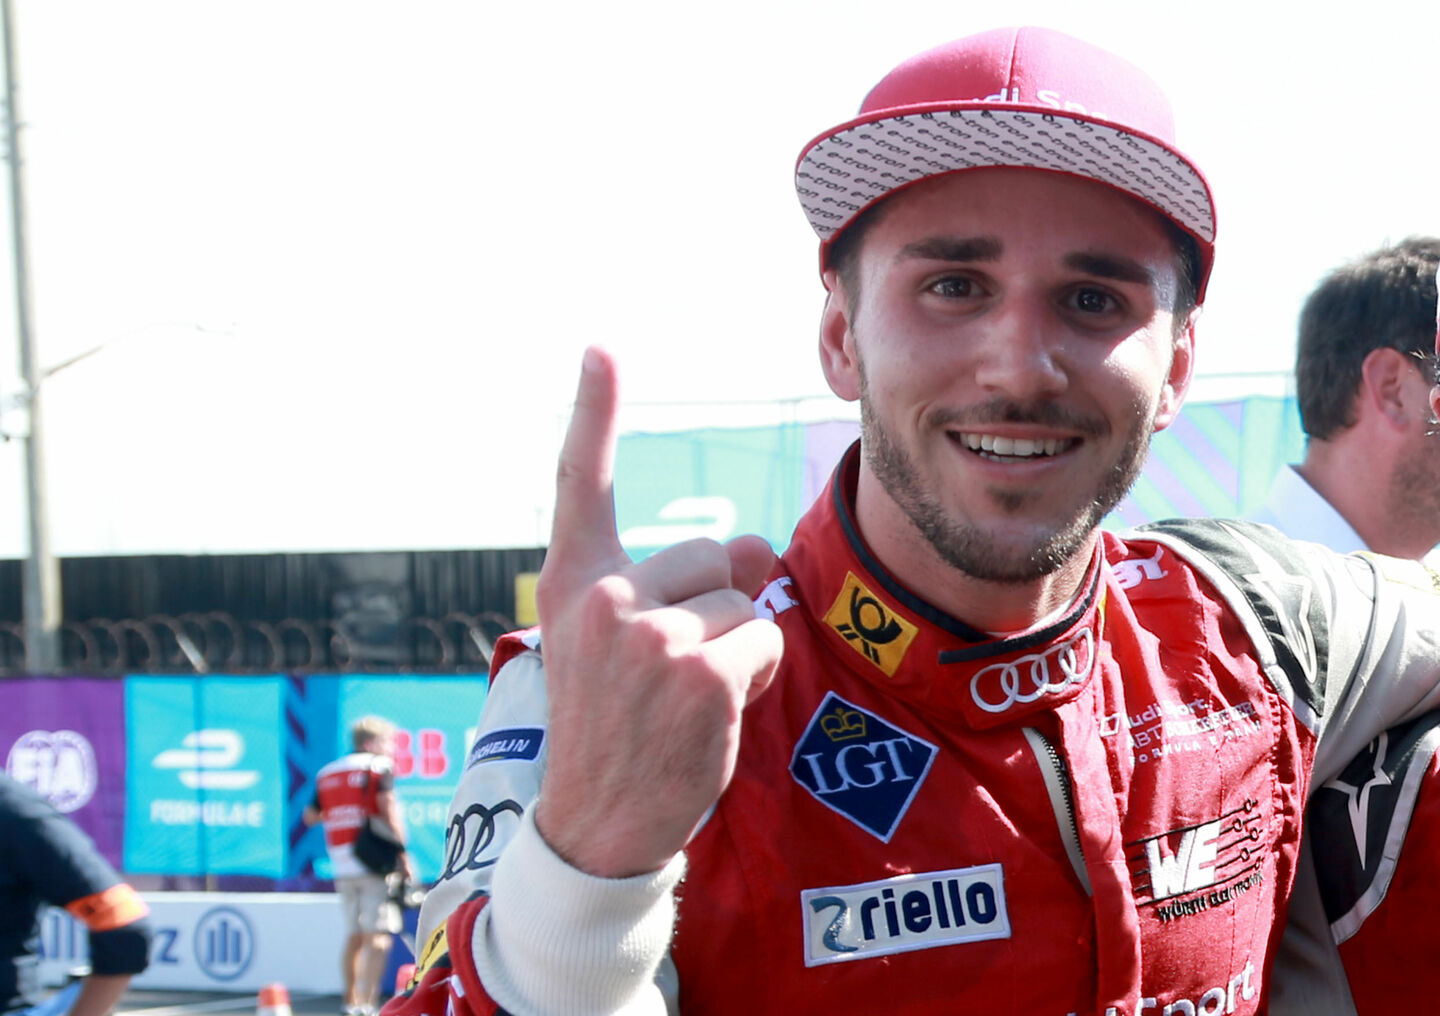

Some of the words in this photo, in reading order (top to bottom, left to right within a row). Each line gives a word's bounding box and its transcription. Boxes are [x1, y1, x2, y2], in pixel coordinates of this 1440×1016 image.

[860, 134, 910, 155] e-tron
[888, 130, 937, 152] e-tron
[918, 129, 966, 150] e-tron
[1037, 130, 1083, 157] e-tron
[1065, 132, 1111, 160] e-tron
[1095, 136, 1139, 164] e-tron
[827, 152, 877, 173] e-tron
[857, 148, 906, 168] e-tron
[1031, 142, 1077, 166] e-tron
[1141, 167, 1184, 196] e-tron
[1148, 157, 1191, 187] e-tron
[801, 737, 913, 795] LGT
[1146, 820, 1221, 901] WE
[860, 879, 997, 940] riello
